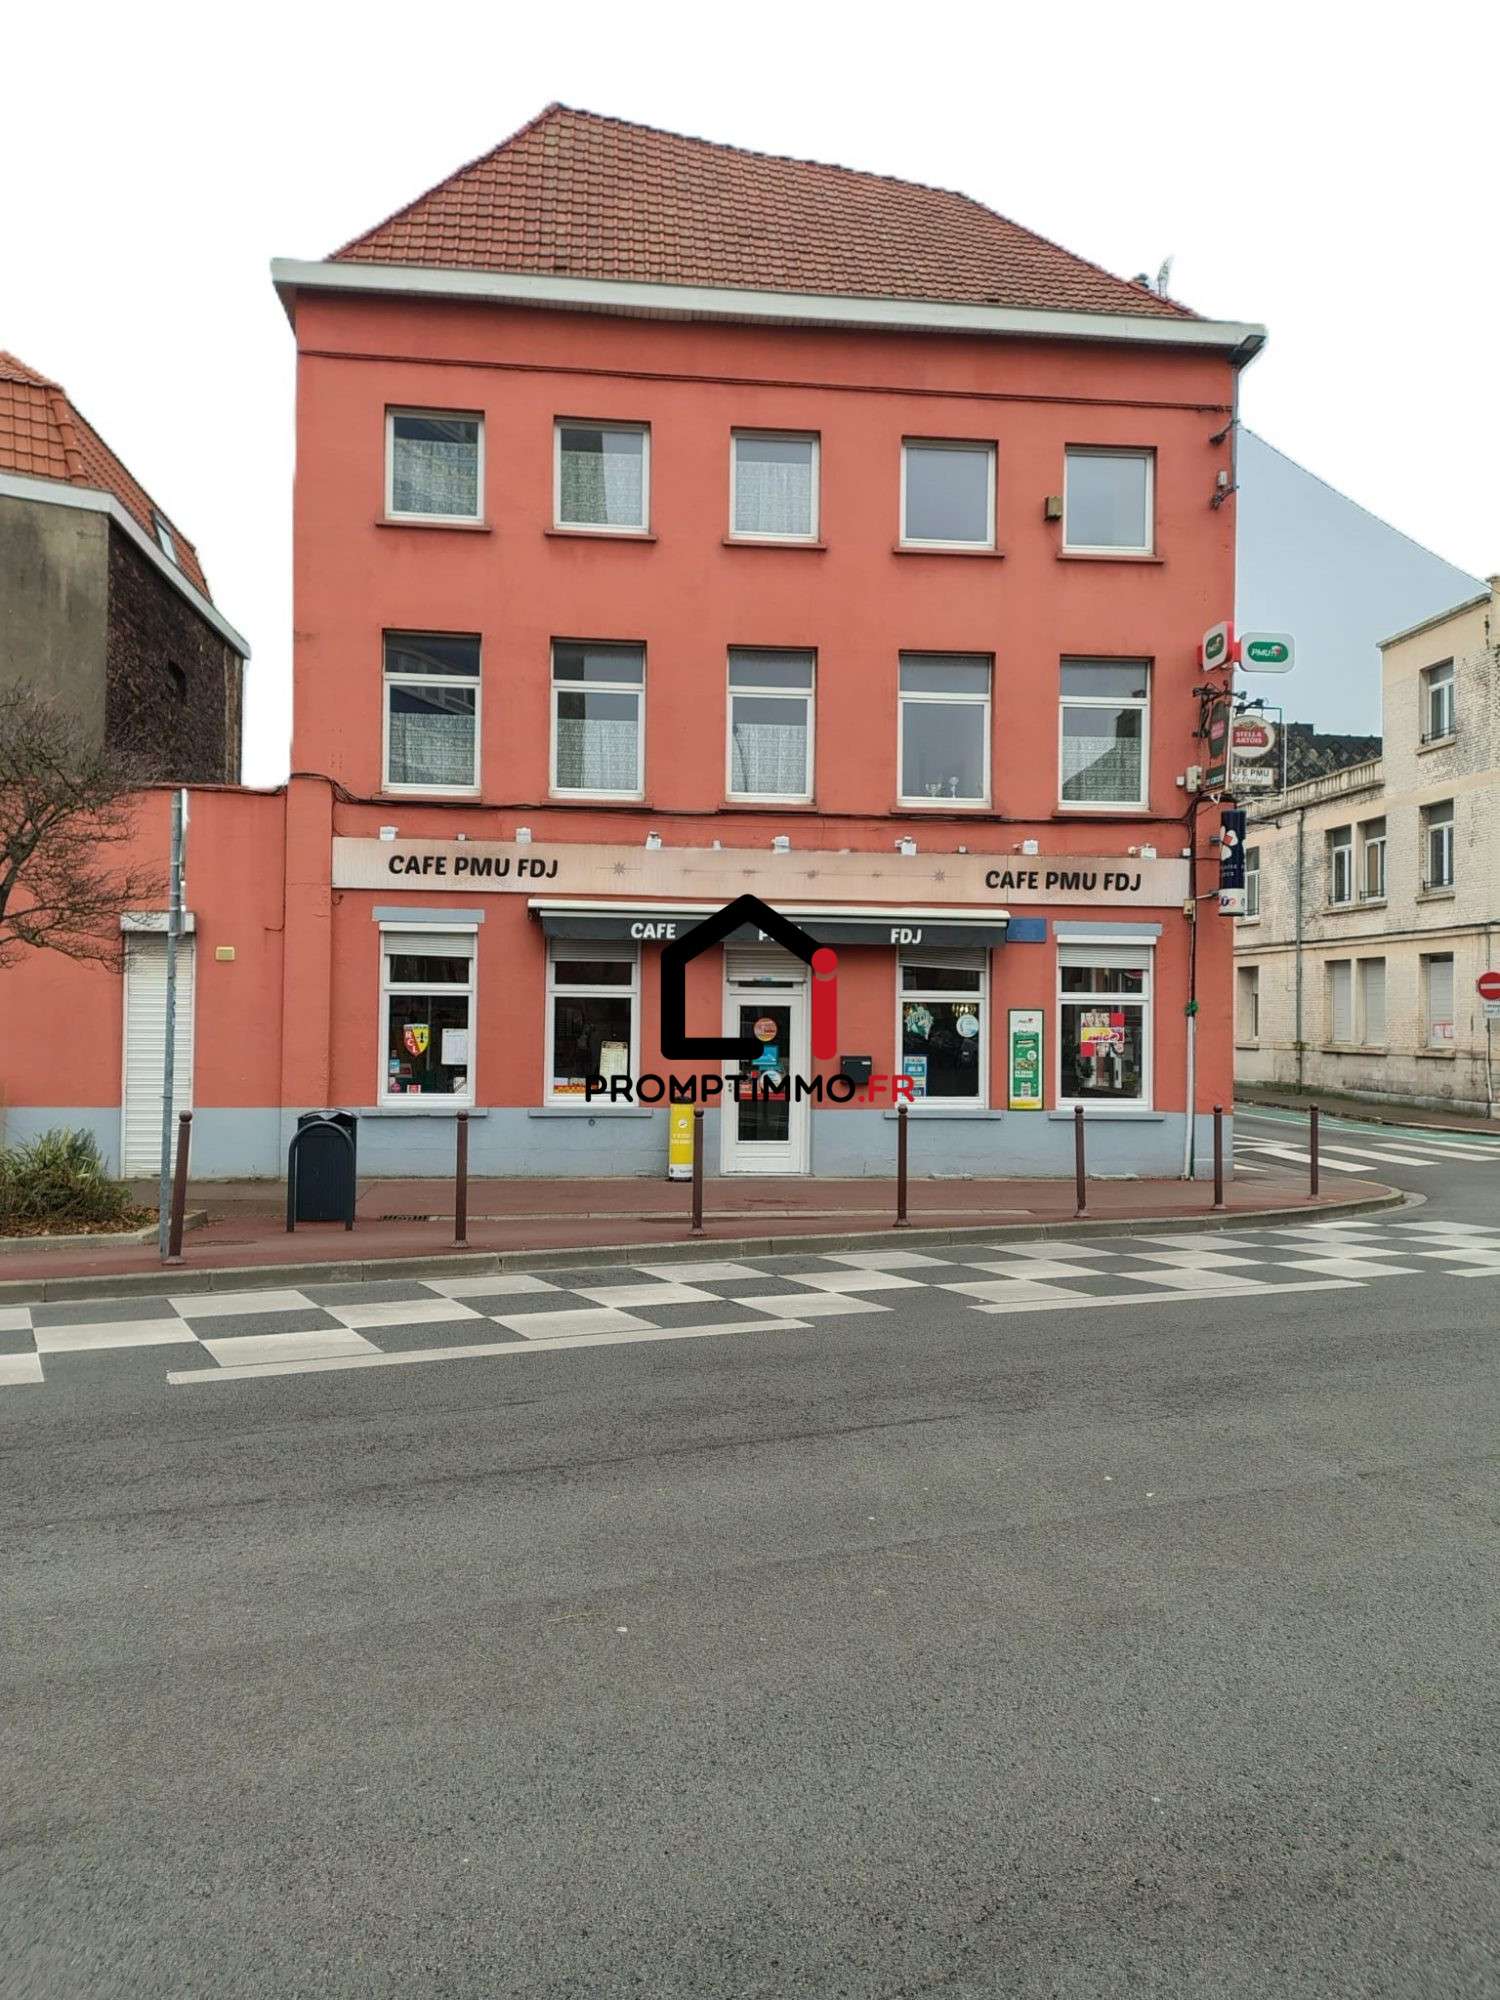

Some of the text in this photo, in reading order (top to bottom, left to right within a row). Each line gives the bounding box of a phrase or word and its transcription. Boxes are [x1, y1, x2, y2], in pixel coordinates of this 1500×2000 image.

[1251, 647, 1271, 656] PMU
[1250, 768, 1269, 777] PMU
[388, 855, 558, 878] CAFE PMU FDJ
[985, 870, 1141, 891] CAFE PMU FDJ
[630, 922, 677, 939] CAFE
[890, 928, 922, 944] FDJ
